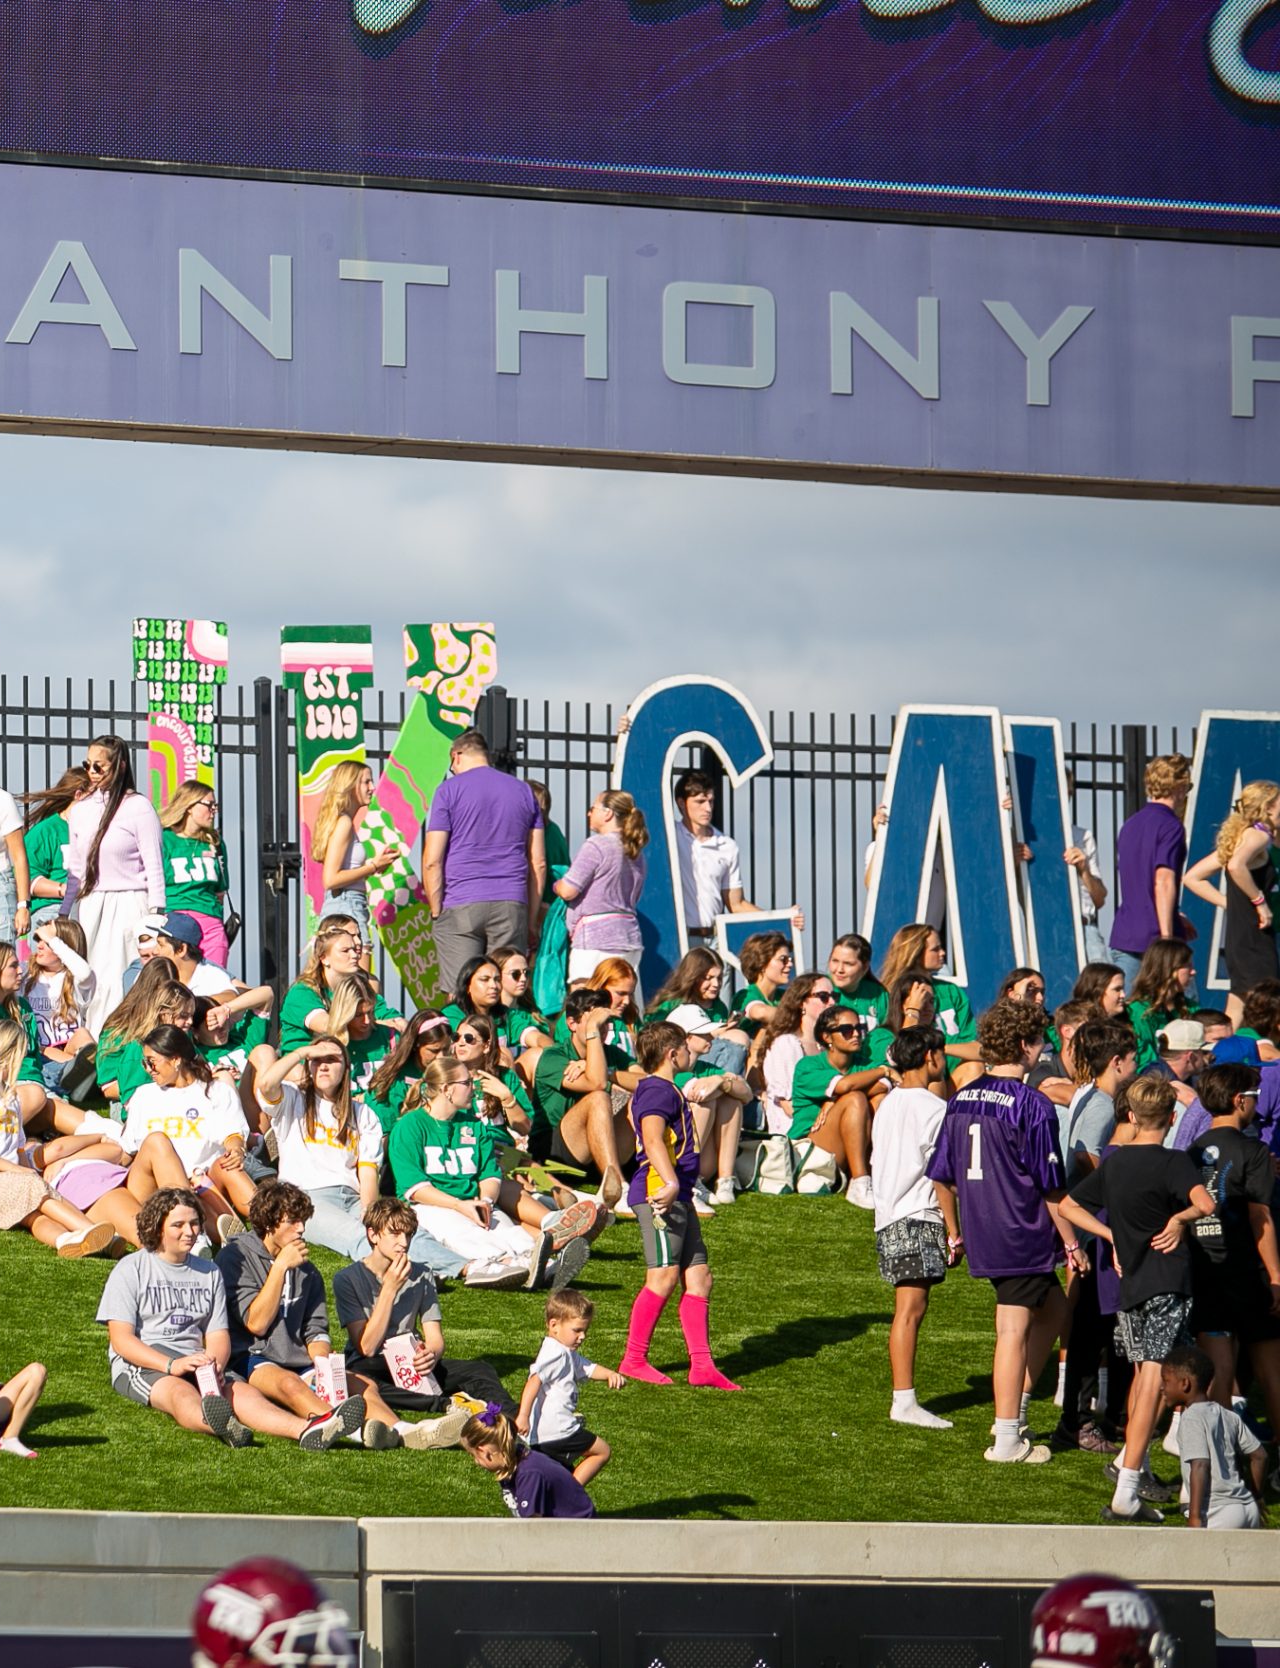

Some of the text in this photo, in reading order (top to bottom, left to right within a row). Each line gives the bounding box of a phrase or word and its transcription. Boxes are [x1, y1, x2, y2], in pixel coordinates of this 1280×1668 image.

[5, 240, 1095, 406] ANTHONY
[166, 620, 182, 641] 13
[148, 641, 165, 660] 13
[303, 666, 359, 701] EST.
[304, 704, 358, 740] 1919
[387, 910, 432, 947] love
[394, 930, 433, 967] you
[967, 1123, 984, 1181] 1
[1196, 1225, 1223, 1237] 2022
[146, 1286, 212, 1315] WILDCATS
